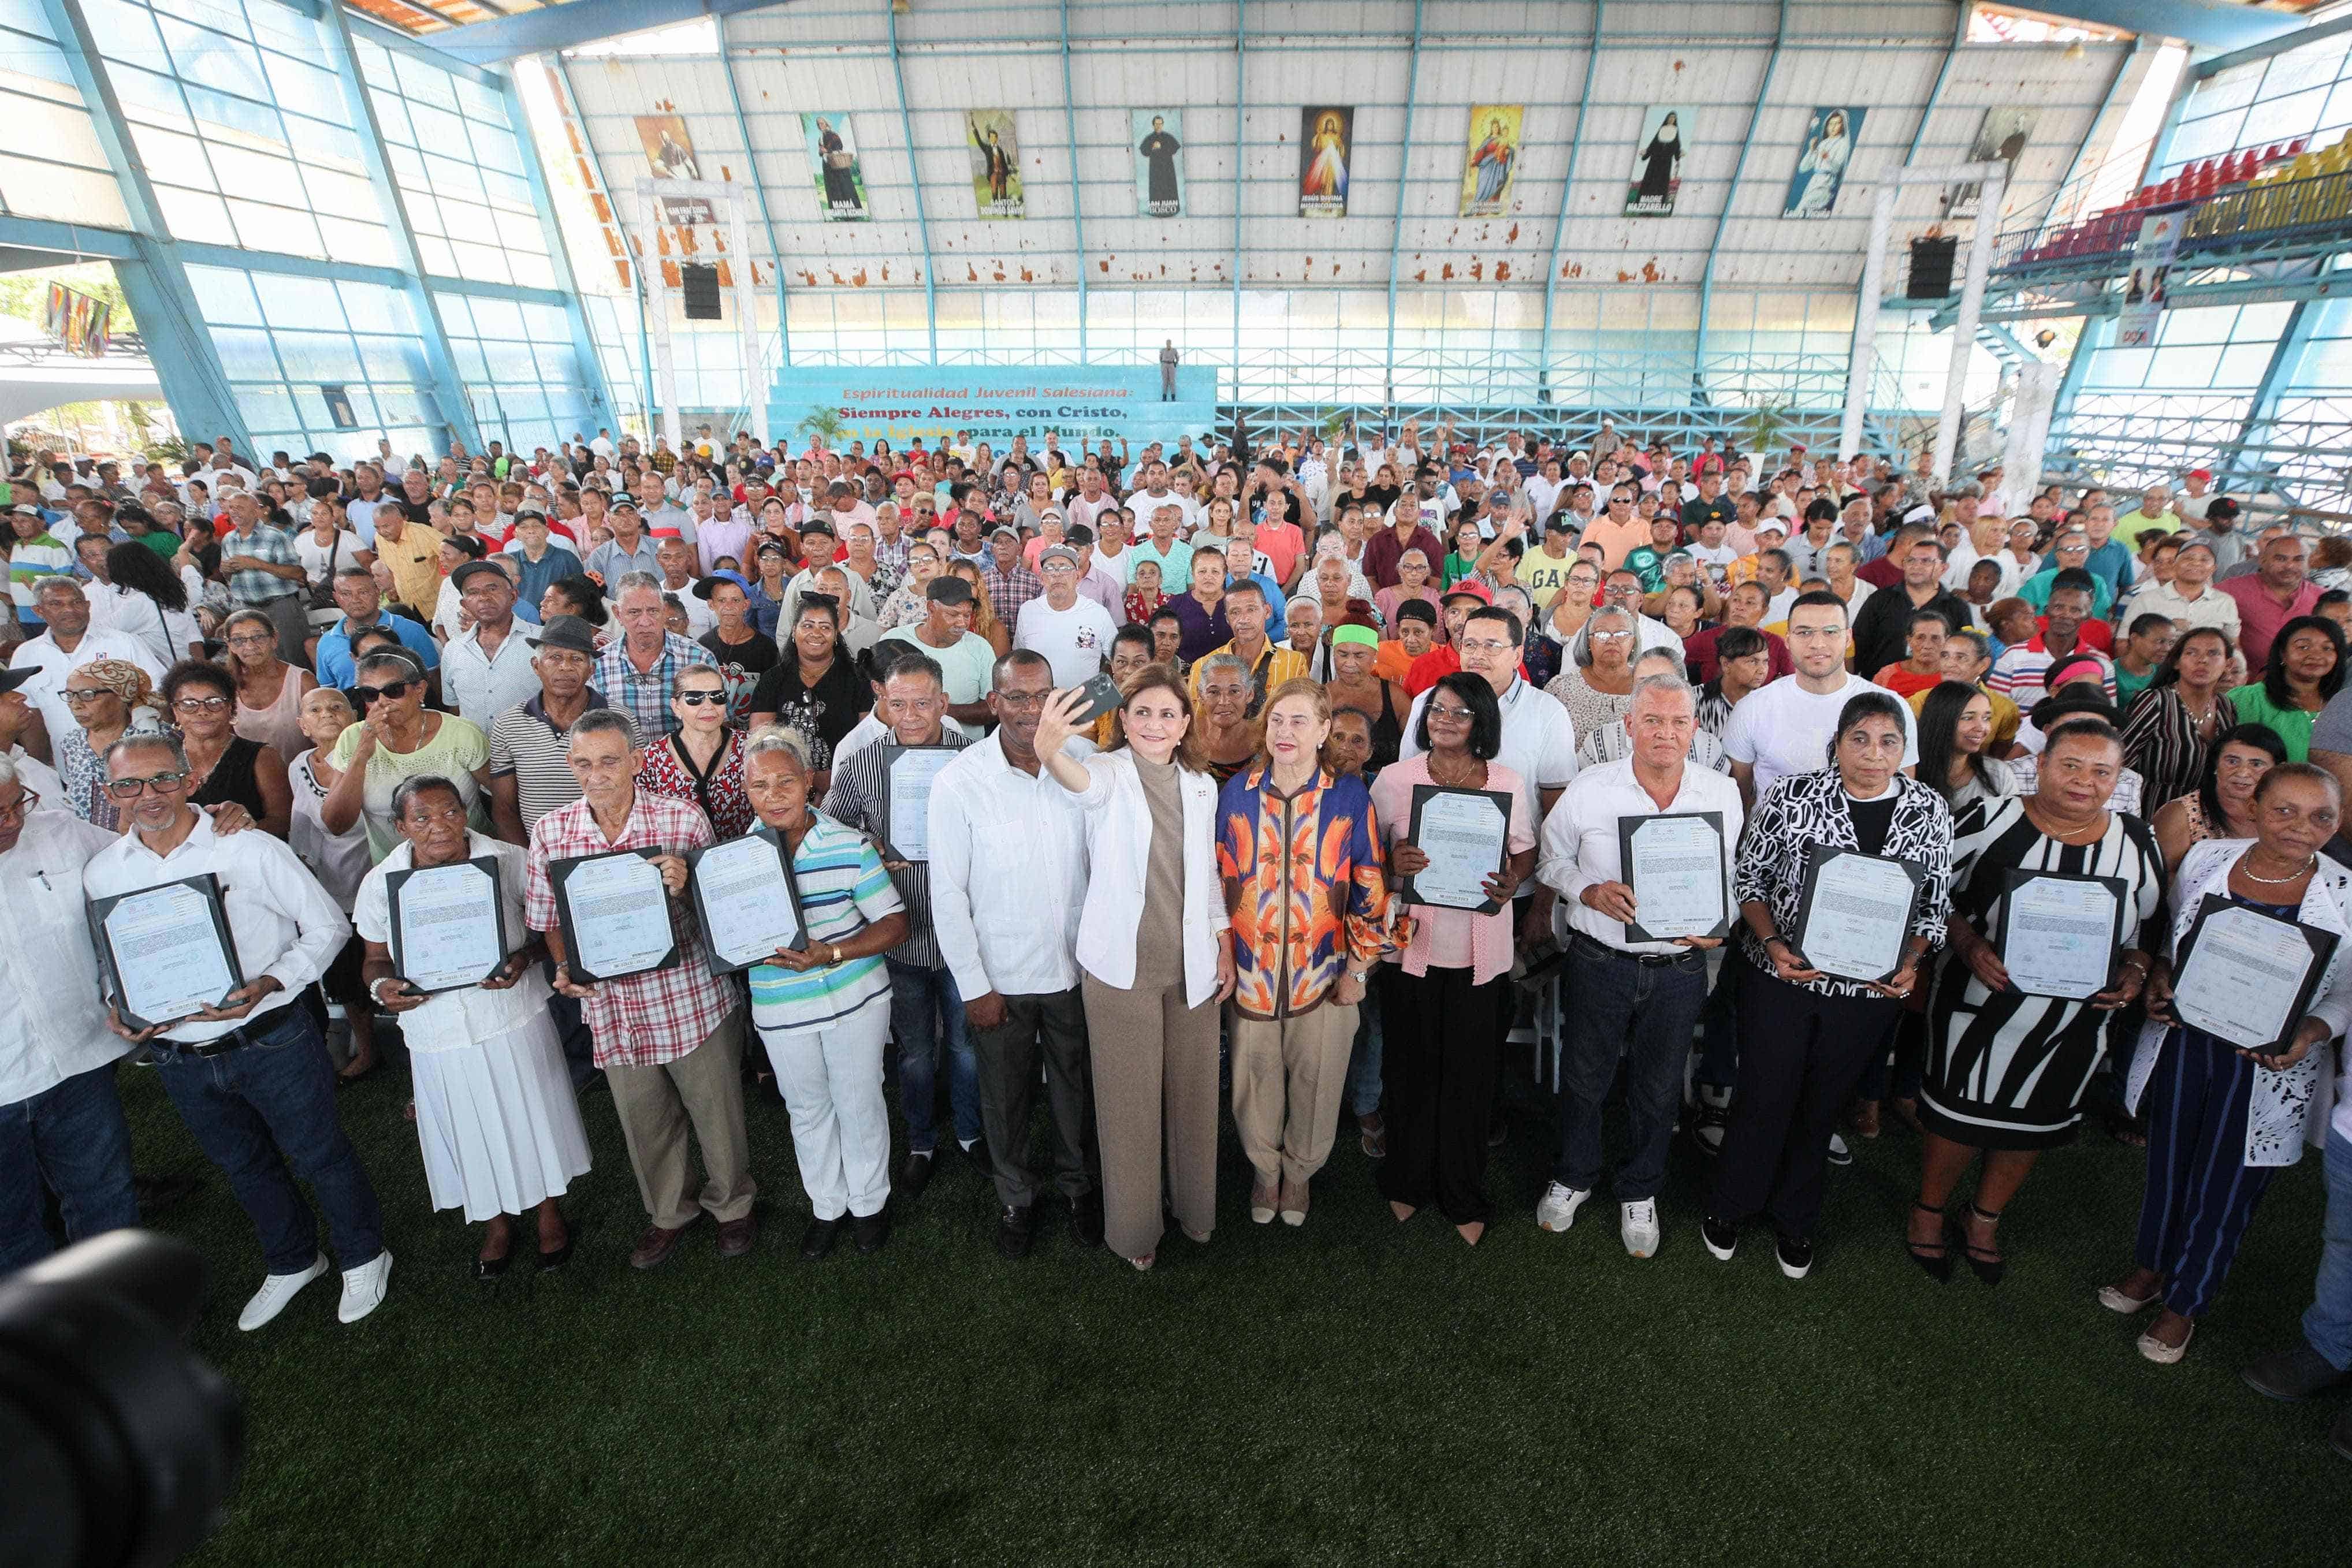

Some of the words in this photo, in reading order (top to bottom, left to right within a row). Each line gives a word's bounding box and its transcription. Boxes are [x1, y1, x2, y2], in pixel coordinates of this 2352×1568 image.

[1639, 195, 1663, 203] MADRE
[843, 388, 969, 401] Espiritualidad
[974, 386, 1037, 398] Juvenil
[1042, 387, 1134, 398] Salesiana:
[838, 407, 922, 420] Siempre
[927, 406, 1010, 420] Alegres,
[1015, 408, 1051, 418] con
[1058, 406, 1127, 419] Cristo,
[967, 427, 1013, 439] para
[1019, 426, 1036, 437] el
[1532, 568, 1569, 589] GA
